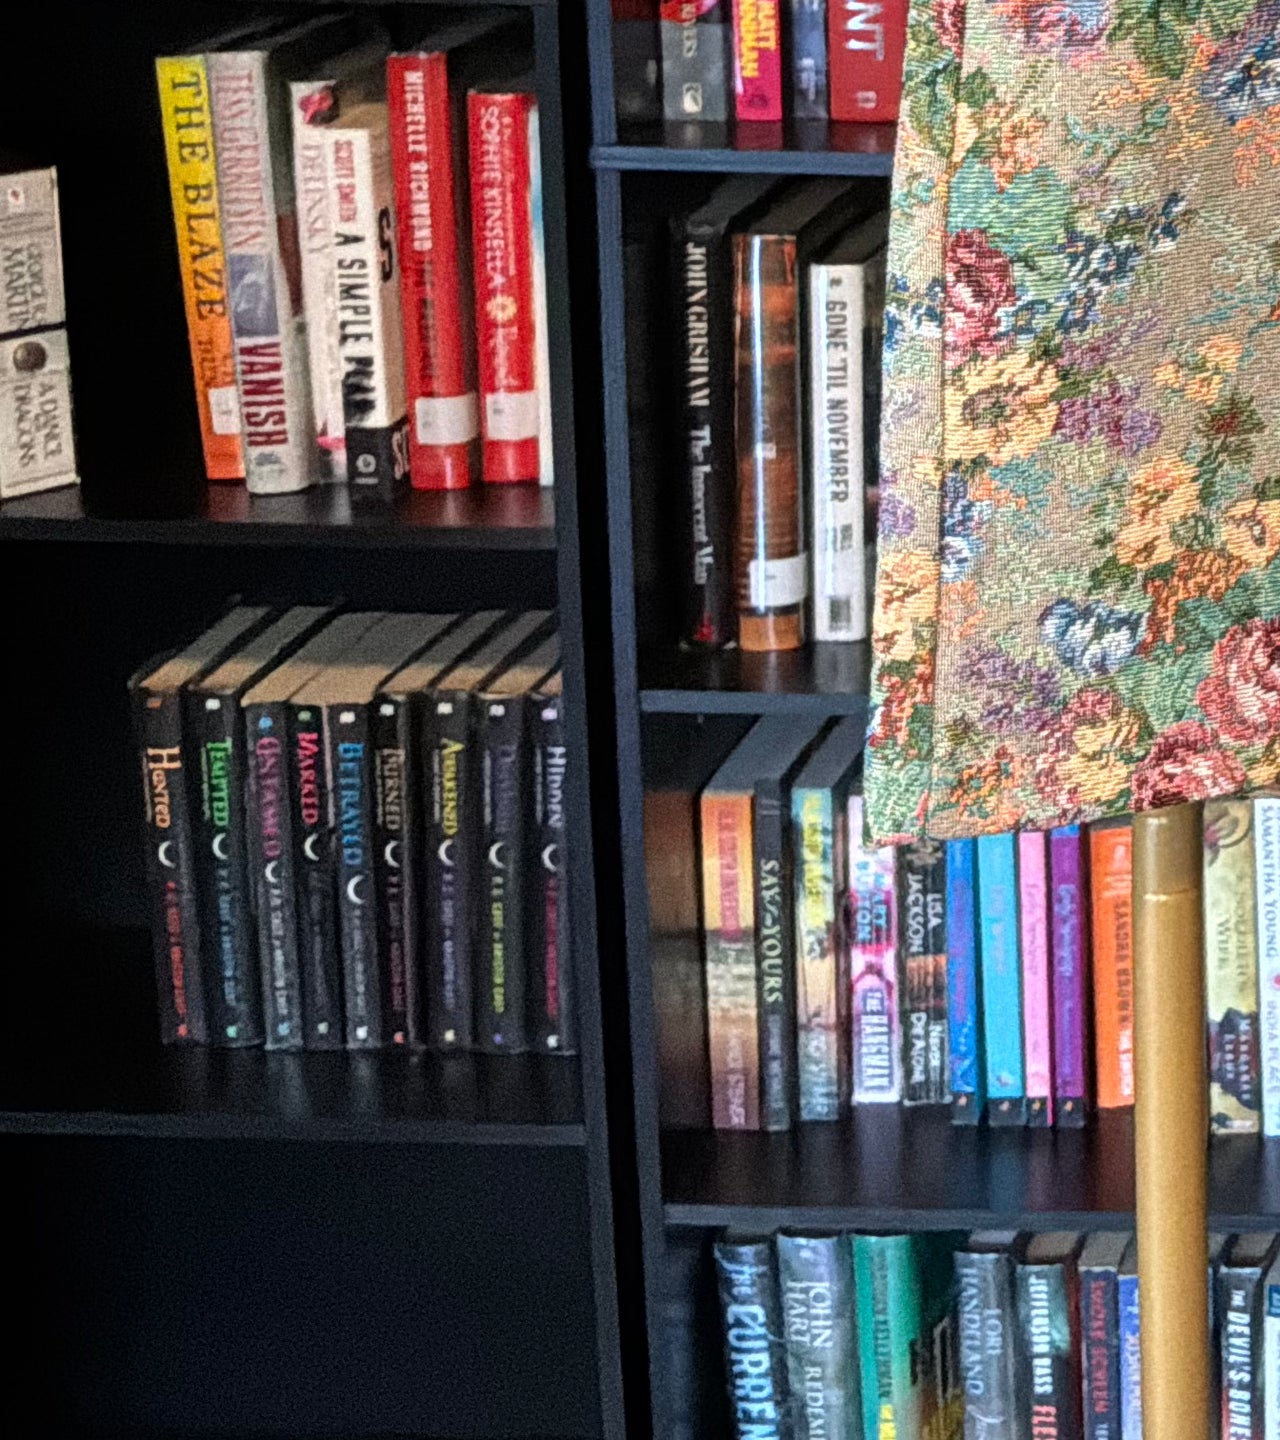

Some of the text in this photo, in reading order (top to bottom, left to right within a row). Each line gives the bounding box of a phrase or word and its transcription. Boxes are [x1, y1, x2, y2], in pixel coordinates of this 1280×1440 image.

[404, 71, 427, 153] MICHELLE
[171, 71, 227, 321] THE BLAZE
[409, 161, 433, 252] RICHMOND
[480, 106, 506, 291] SOPHIE KINSELLA
[335, 232, 374, 348] A SIMPLE
[825, 300, 847, 350] GONE
[238, 341, 288, 448] VANISH
[687, 306, 710, 408] GRISHAM
[826, 395, 850, 503] NOVEMBER
[297, 732, 319, 824] MARKED
[338, 743, 364, 865] BETRAYED
[906, 873, 924, 953] JACKSON
[1261, 805, 1279, 958] SAMANTHA YOUNG
[760, 925, 783, 1004] YOURS
[861, 1014, 889, 1088] HANGMAN
[785, 1280, 809, 1347] HART
[807, 1280, 833, 1349] JOHN
[1029, 1277, 1053, 1395] JEFFERSON BASS
[1227, 1312, 1251, 1383] DEVIL'S
